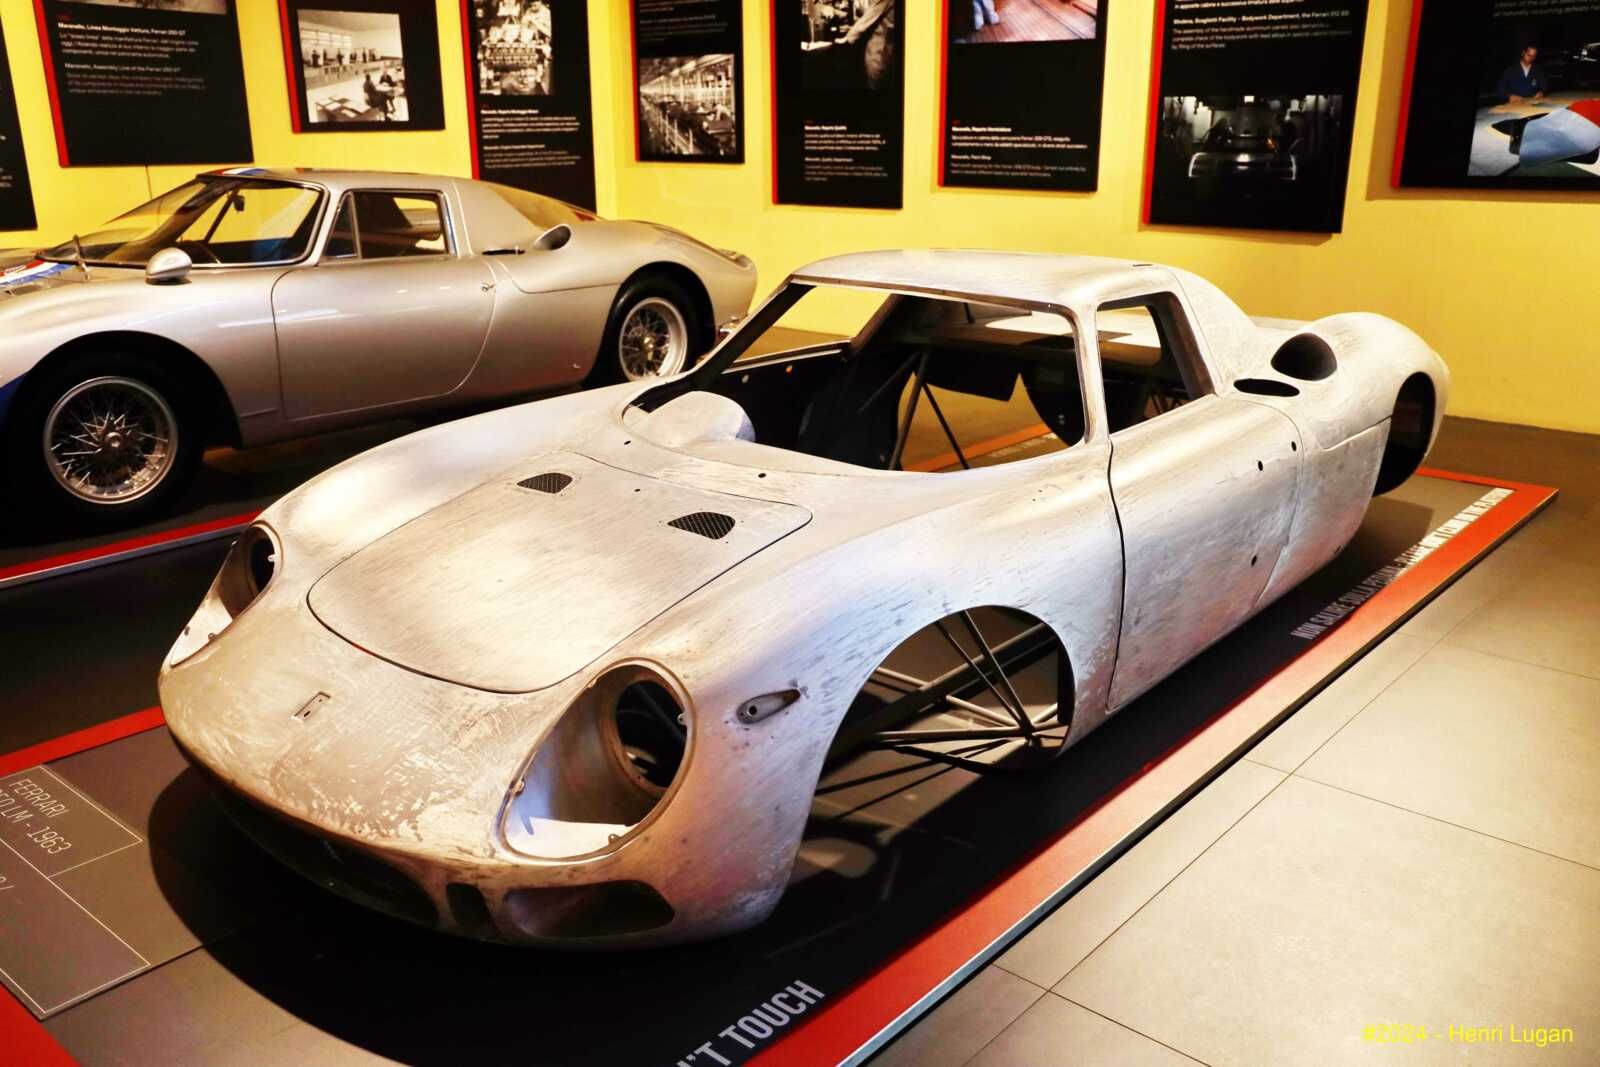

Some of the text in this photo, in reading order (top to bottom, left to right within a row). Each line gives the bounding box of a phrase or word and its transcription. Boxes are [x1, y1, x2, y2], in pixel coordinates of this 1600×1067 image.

[1290, 622, 1327, 640] NON
[8, 778, 70, 818] FERRARI
[0, 805, 34, 824] LM
[27, 826, 72, 855] 1963
[677, 979, 825, 1067] 'T TOUCH
